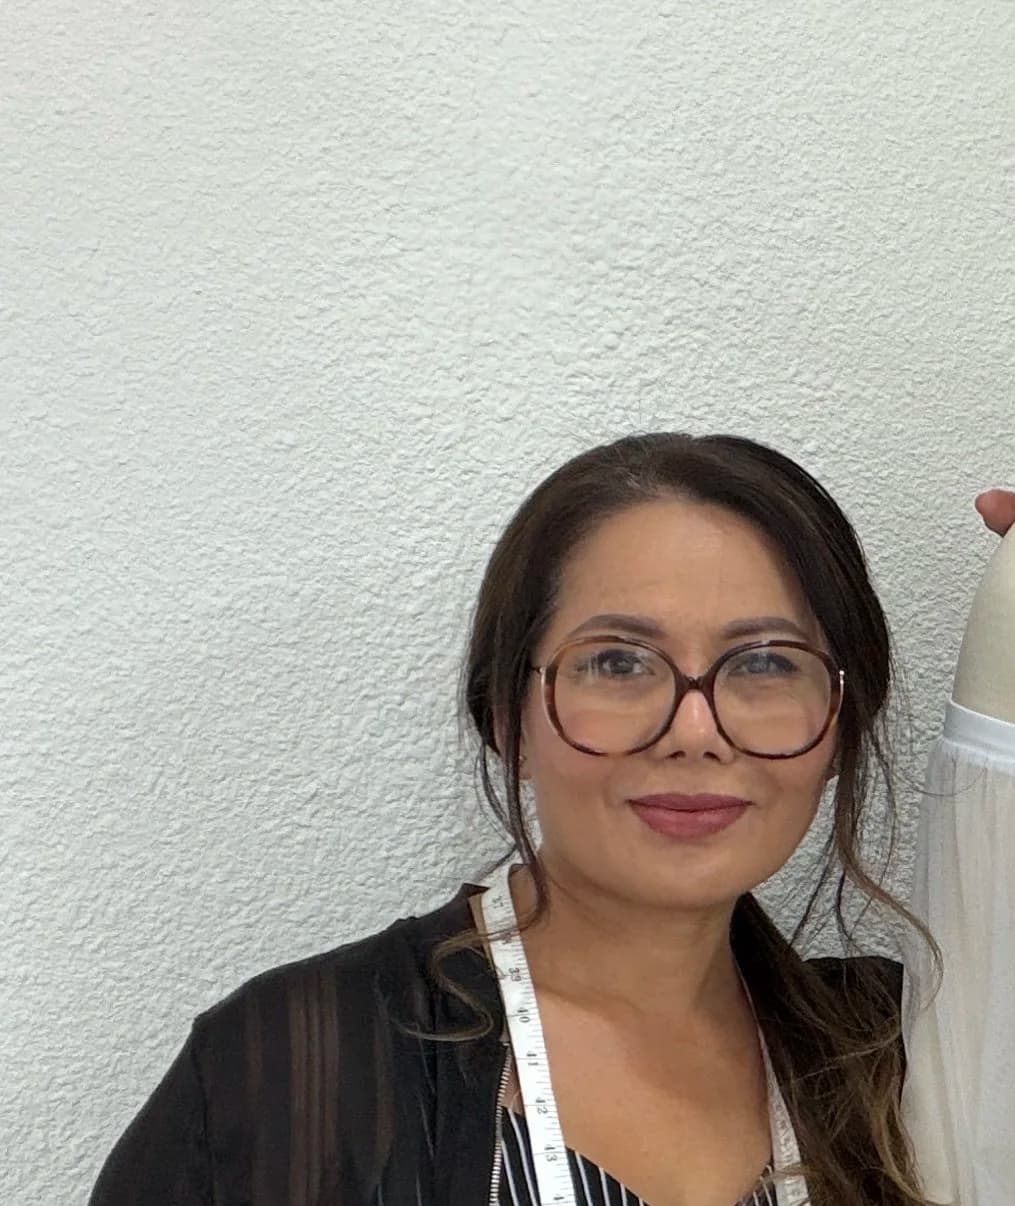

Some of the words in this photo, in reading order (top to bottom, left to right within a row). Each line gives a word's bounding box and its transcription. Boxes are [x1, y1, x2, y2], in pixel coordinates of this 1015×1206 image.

[508, 967, 521, 982] 39
[517, 1007, 531, 1023] 40
[535, 1096, 548, 1115] 42
[544, 1144, 558, 1162] 43
